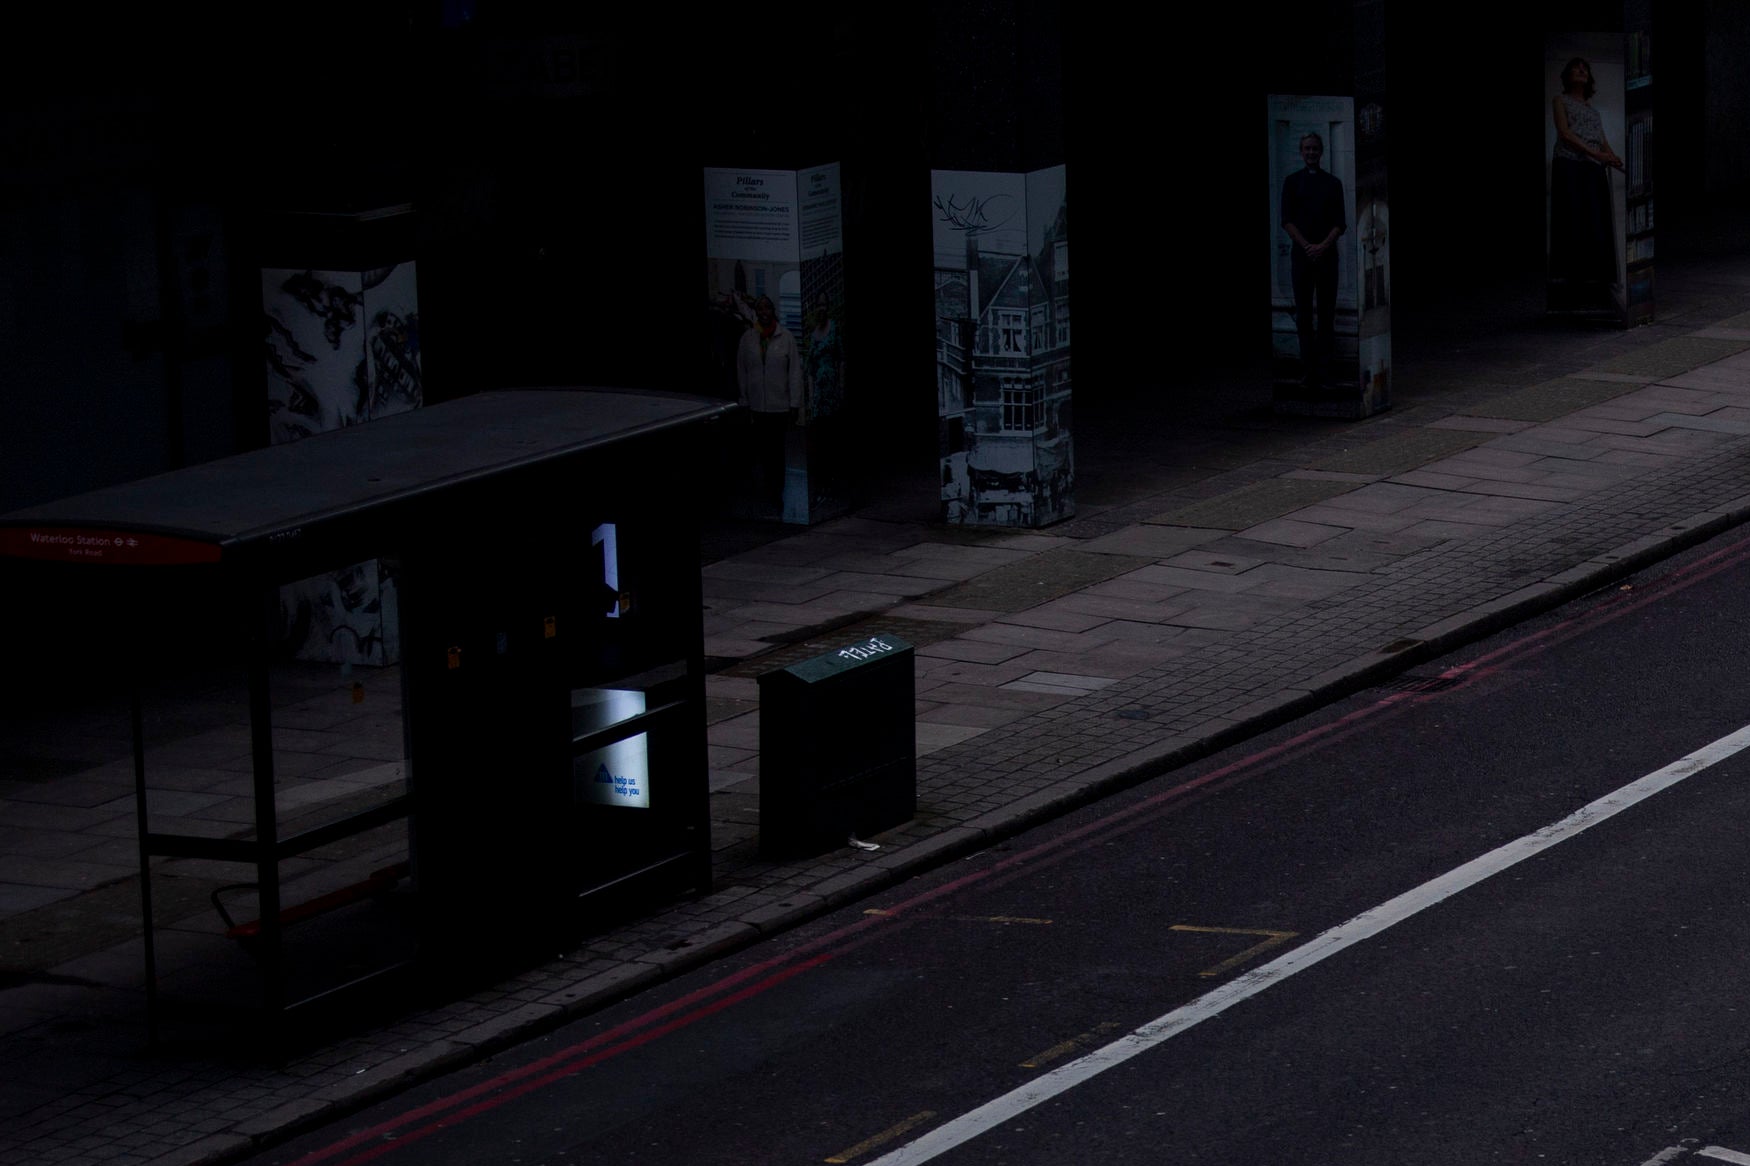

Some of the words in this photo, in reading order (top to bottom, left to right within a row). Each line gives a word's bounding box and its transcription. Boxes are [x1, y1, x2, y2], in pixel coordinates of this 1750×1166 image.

[736, 176, 764, 186] Pillars
[30, 532, 74, 545] Waterloo
[76, 534, 111, 547] Station
[614, 775, 627, 785] help
[614, 786, 627, 796] help
[629, 787, 639, 797] you
